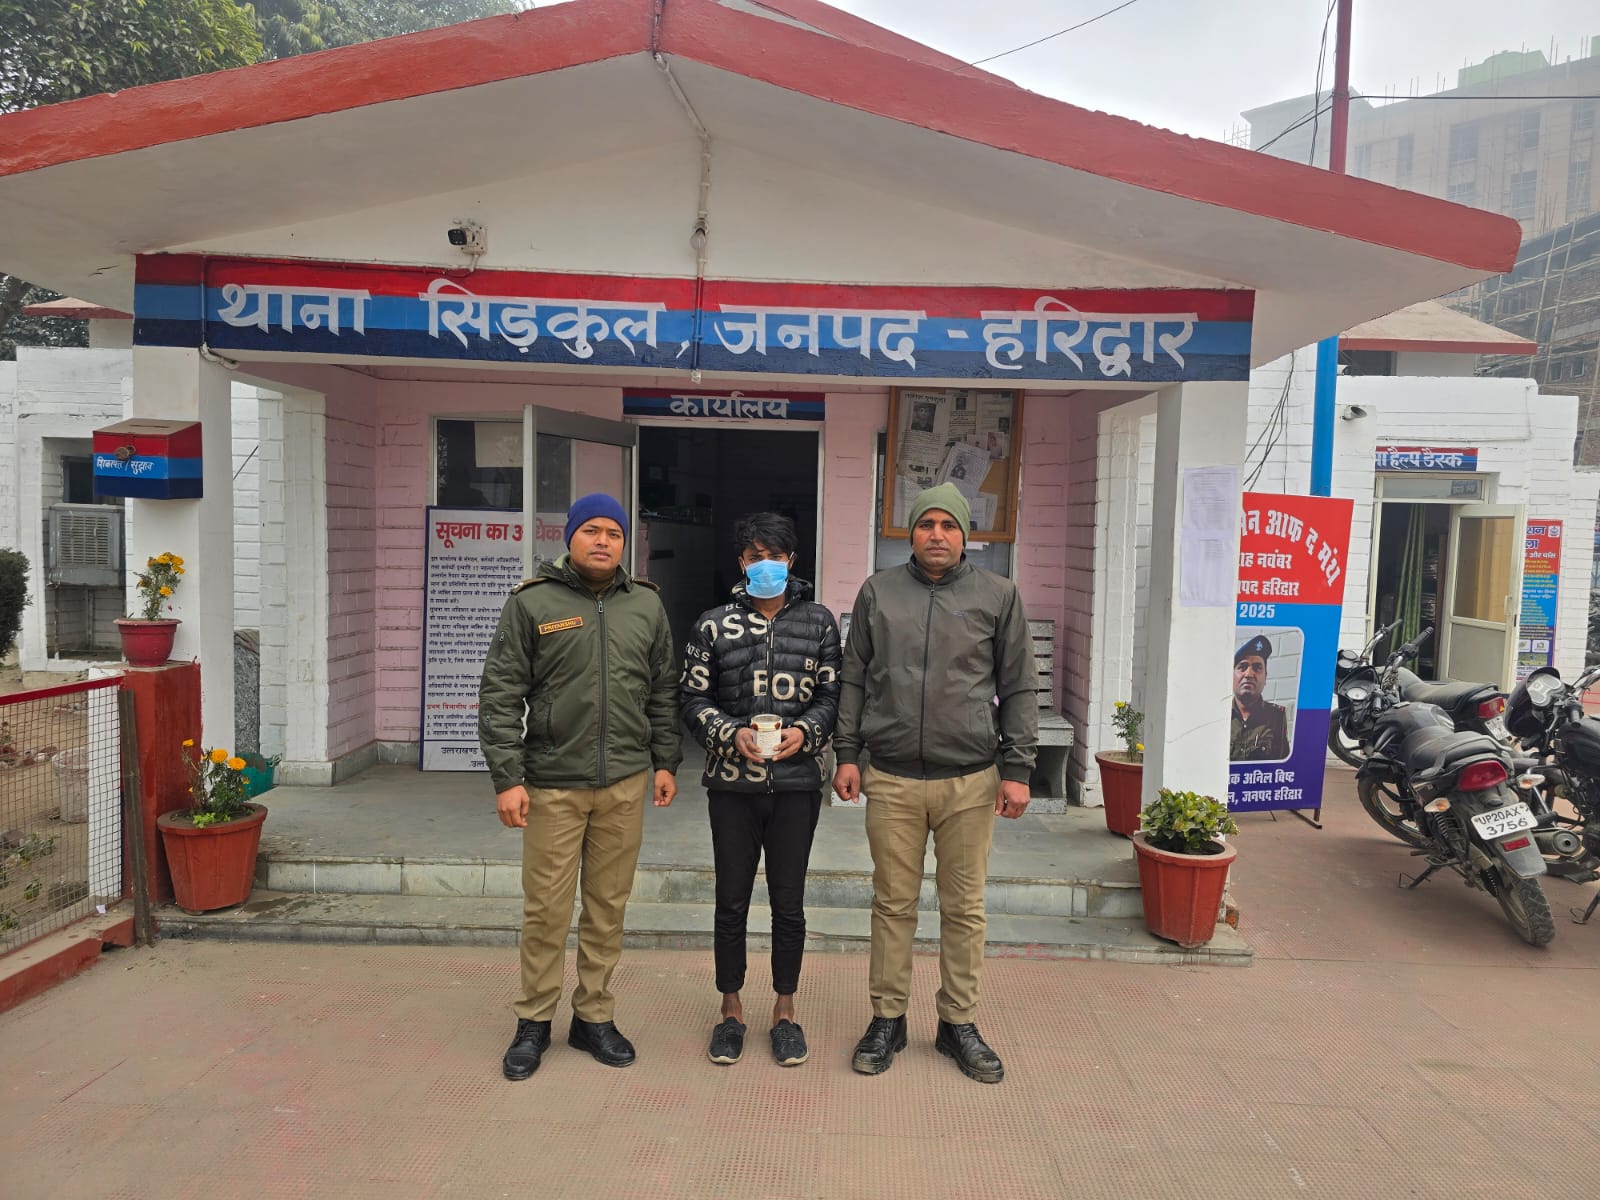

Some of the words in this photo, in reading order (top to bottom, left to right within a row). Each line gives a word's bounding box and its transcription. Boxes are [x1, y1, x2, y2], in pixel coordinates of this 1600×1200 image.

[217, 283, 371, 336] थाना
[713, 302, 927, 370] जनपद
[979, 296, 1199, 377] हरिद्वार
[669, 390, 790, 418] कार्यालय
[436, 521, 483, 549] सूचना
[485, 522, 509, 541] का
[1257, 549, 1292, 569] नवंबर
[1262, 576, 1300, 597] हरिद्वार
[1239, 604, 1275, 618] 2025
[1242, 769, 1273, 785] अनिल
[1241, 789, 1273, 803] जनपद
[1478, 806, 1521, 826] UP20AX
[1486, 817, 1529, 836] 3756
